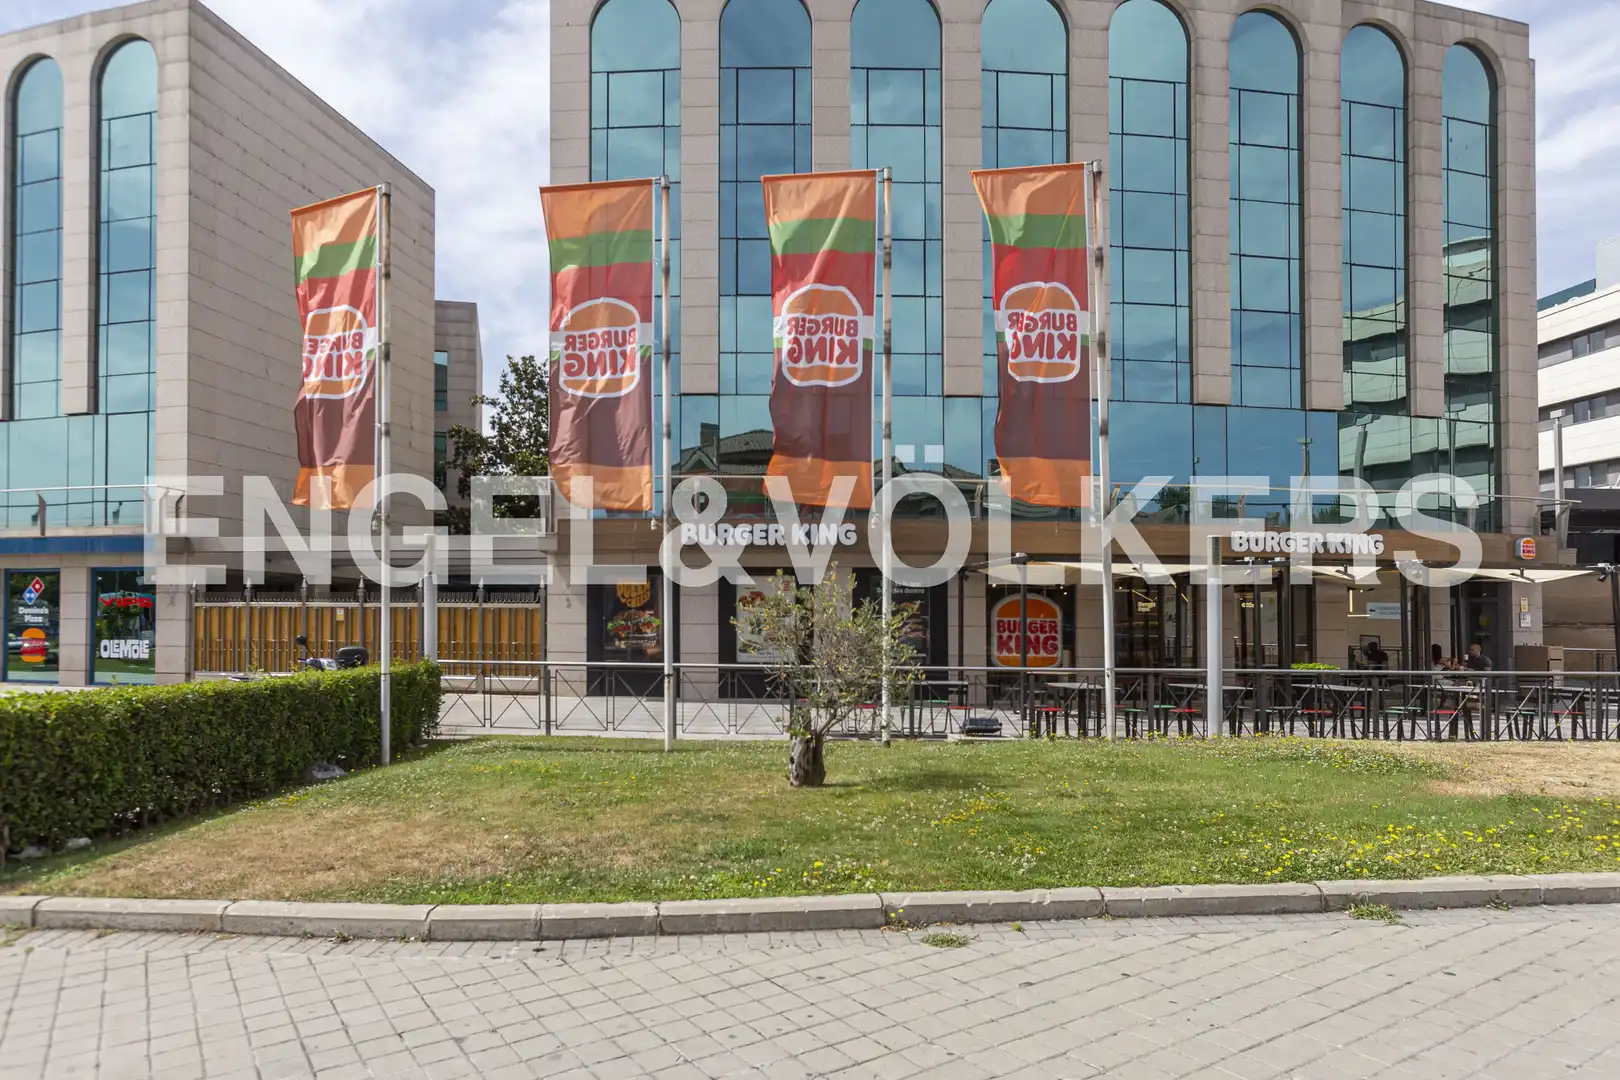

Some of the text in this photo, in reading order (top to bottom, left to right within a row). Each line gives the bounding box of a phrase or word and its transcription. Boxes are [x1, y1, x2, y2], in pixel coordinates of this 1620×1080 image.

[681, 522, 858, 546] BURGER KING
[1230, 530, 1385, 555] BURGER KING
[99, 597, 153, 608] VIPS
[996, 634, 1059, 655] KING
